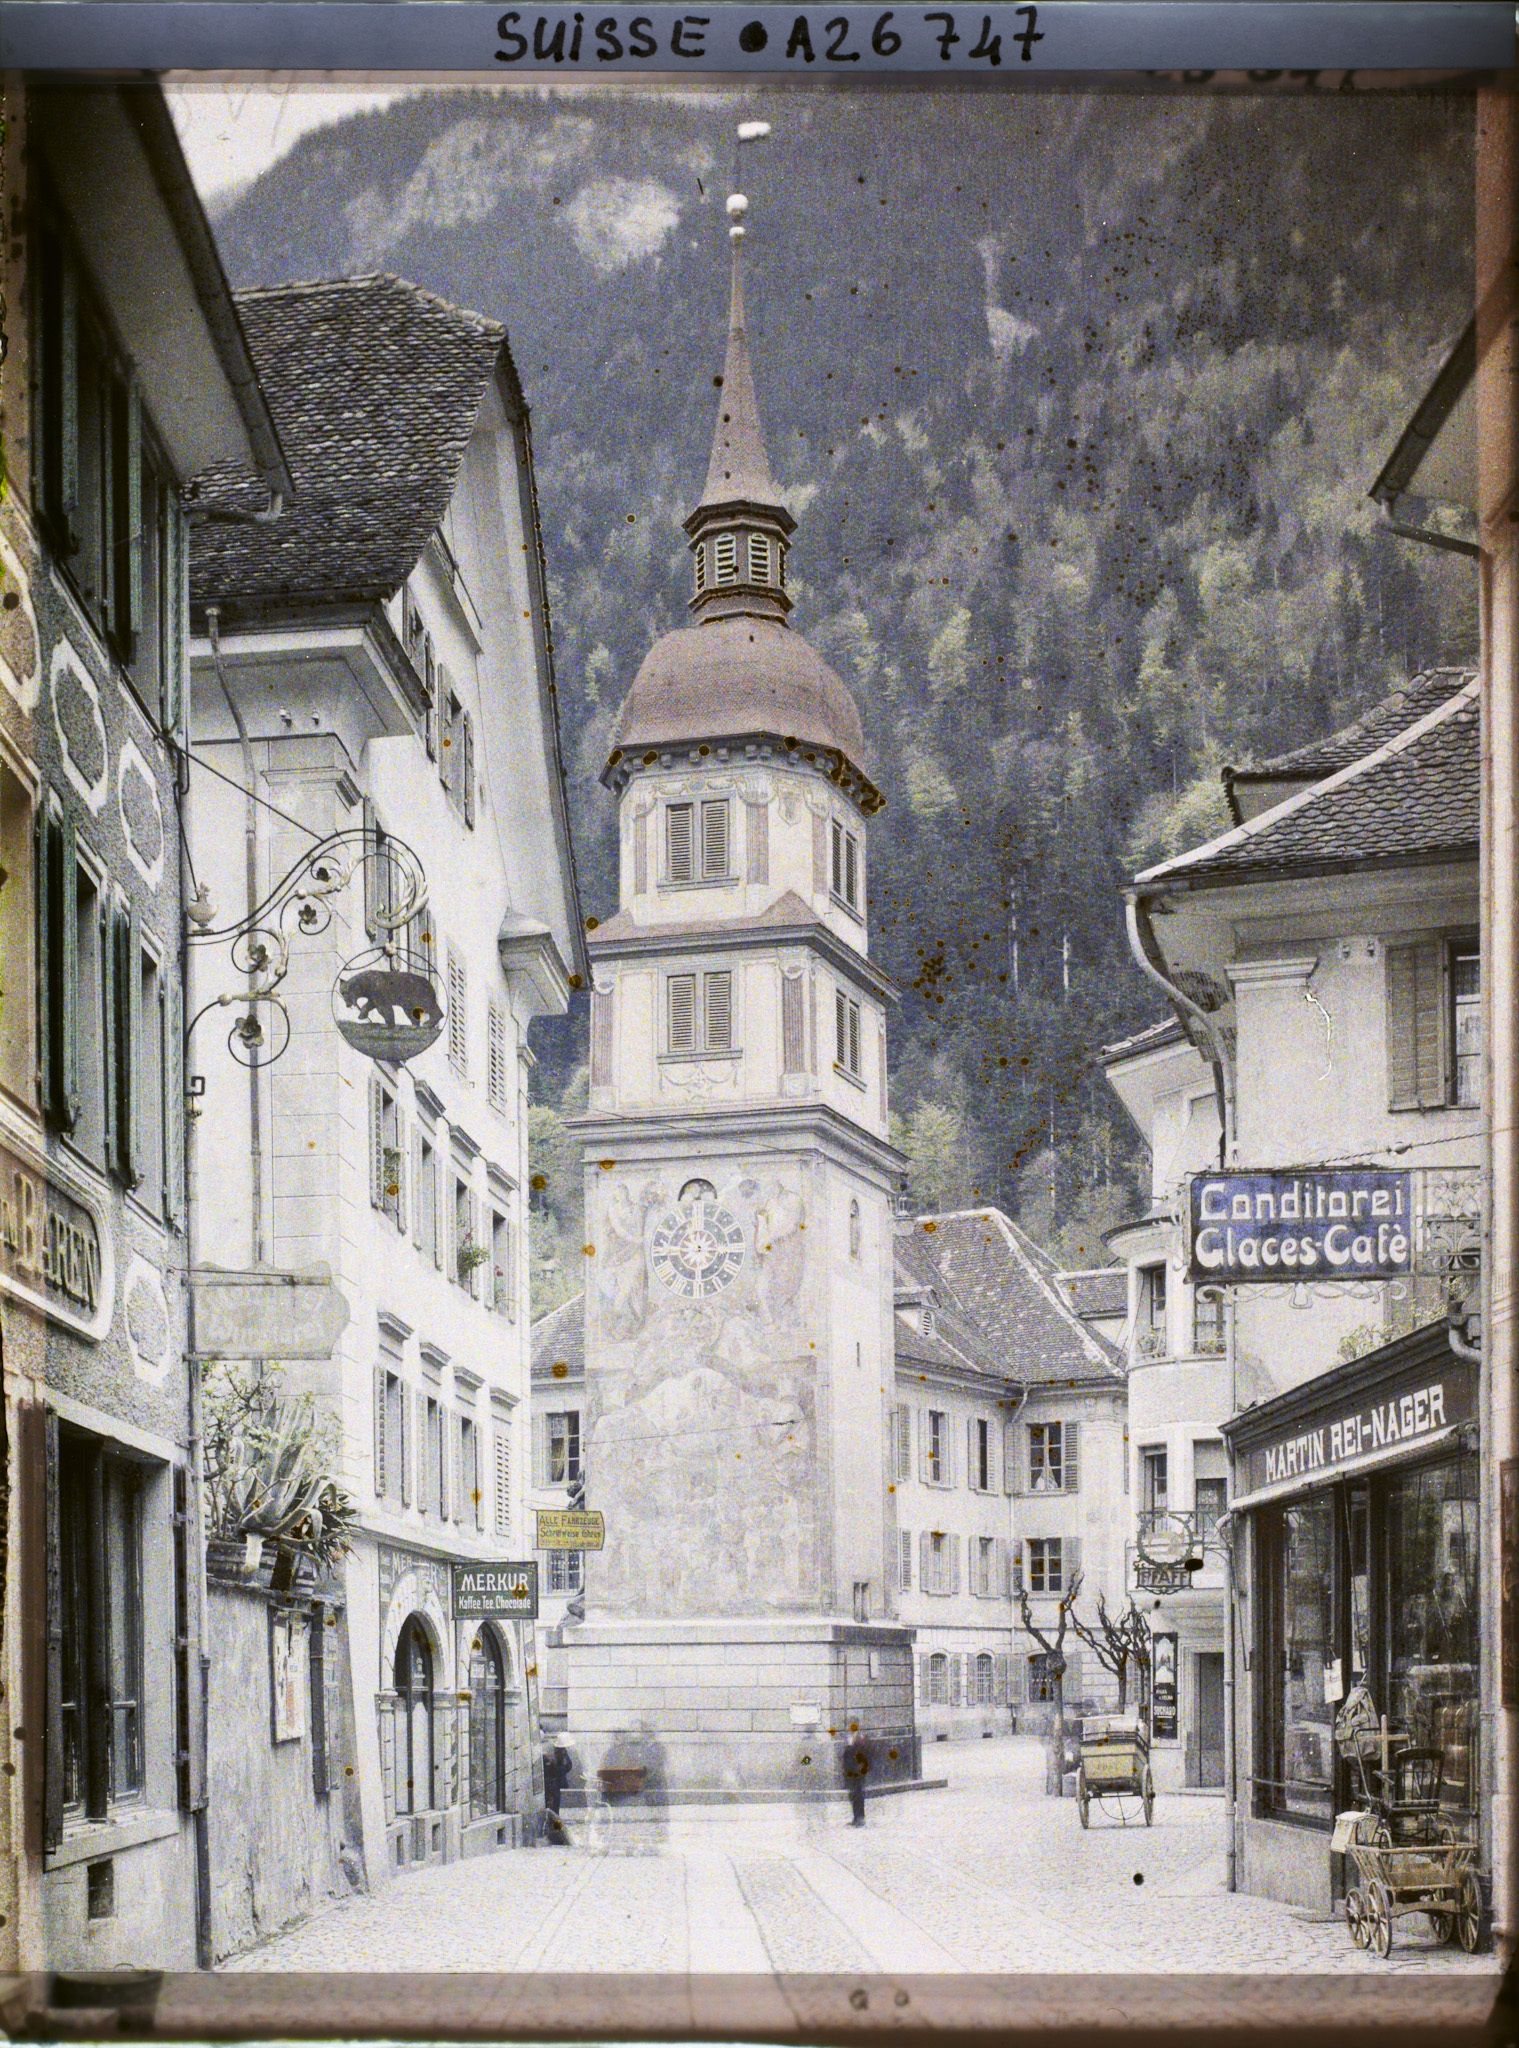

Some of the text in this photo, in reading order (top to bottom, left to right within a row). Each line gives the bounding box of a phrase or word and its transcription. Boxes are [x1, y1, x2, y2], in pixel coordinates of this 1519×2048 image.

[1200, 1181, 1403, 1220] Conditorei
[1265, 1384, 1447, 1483] MARTIN REI-NAGER
[539, 1515, 558, 1526] ALLE
[461, 1573, 529, 1591] MERKUR
